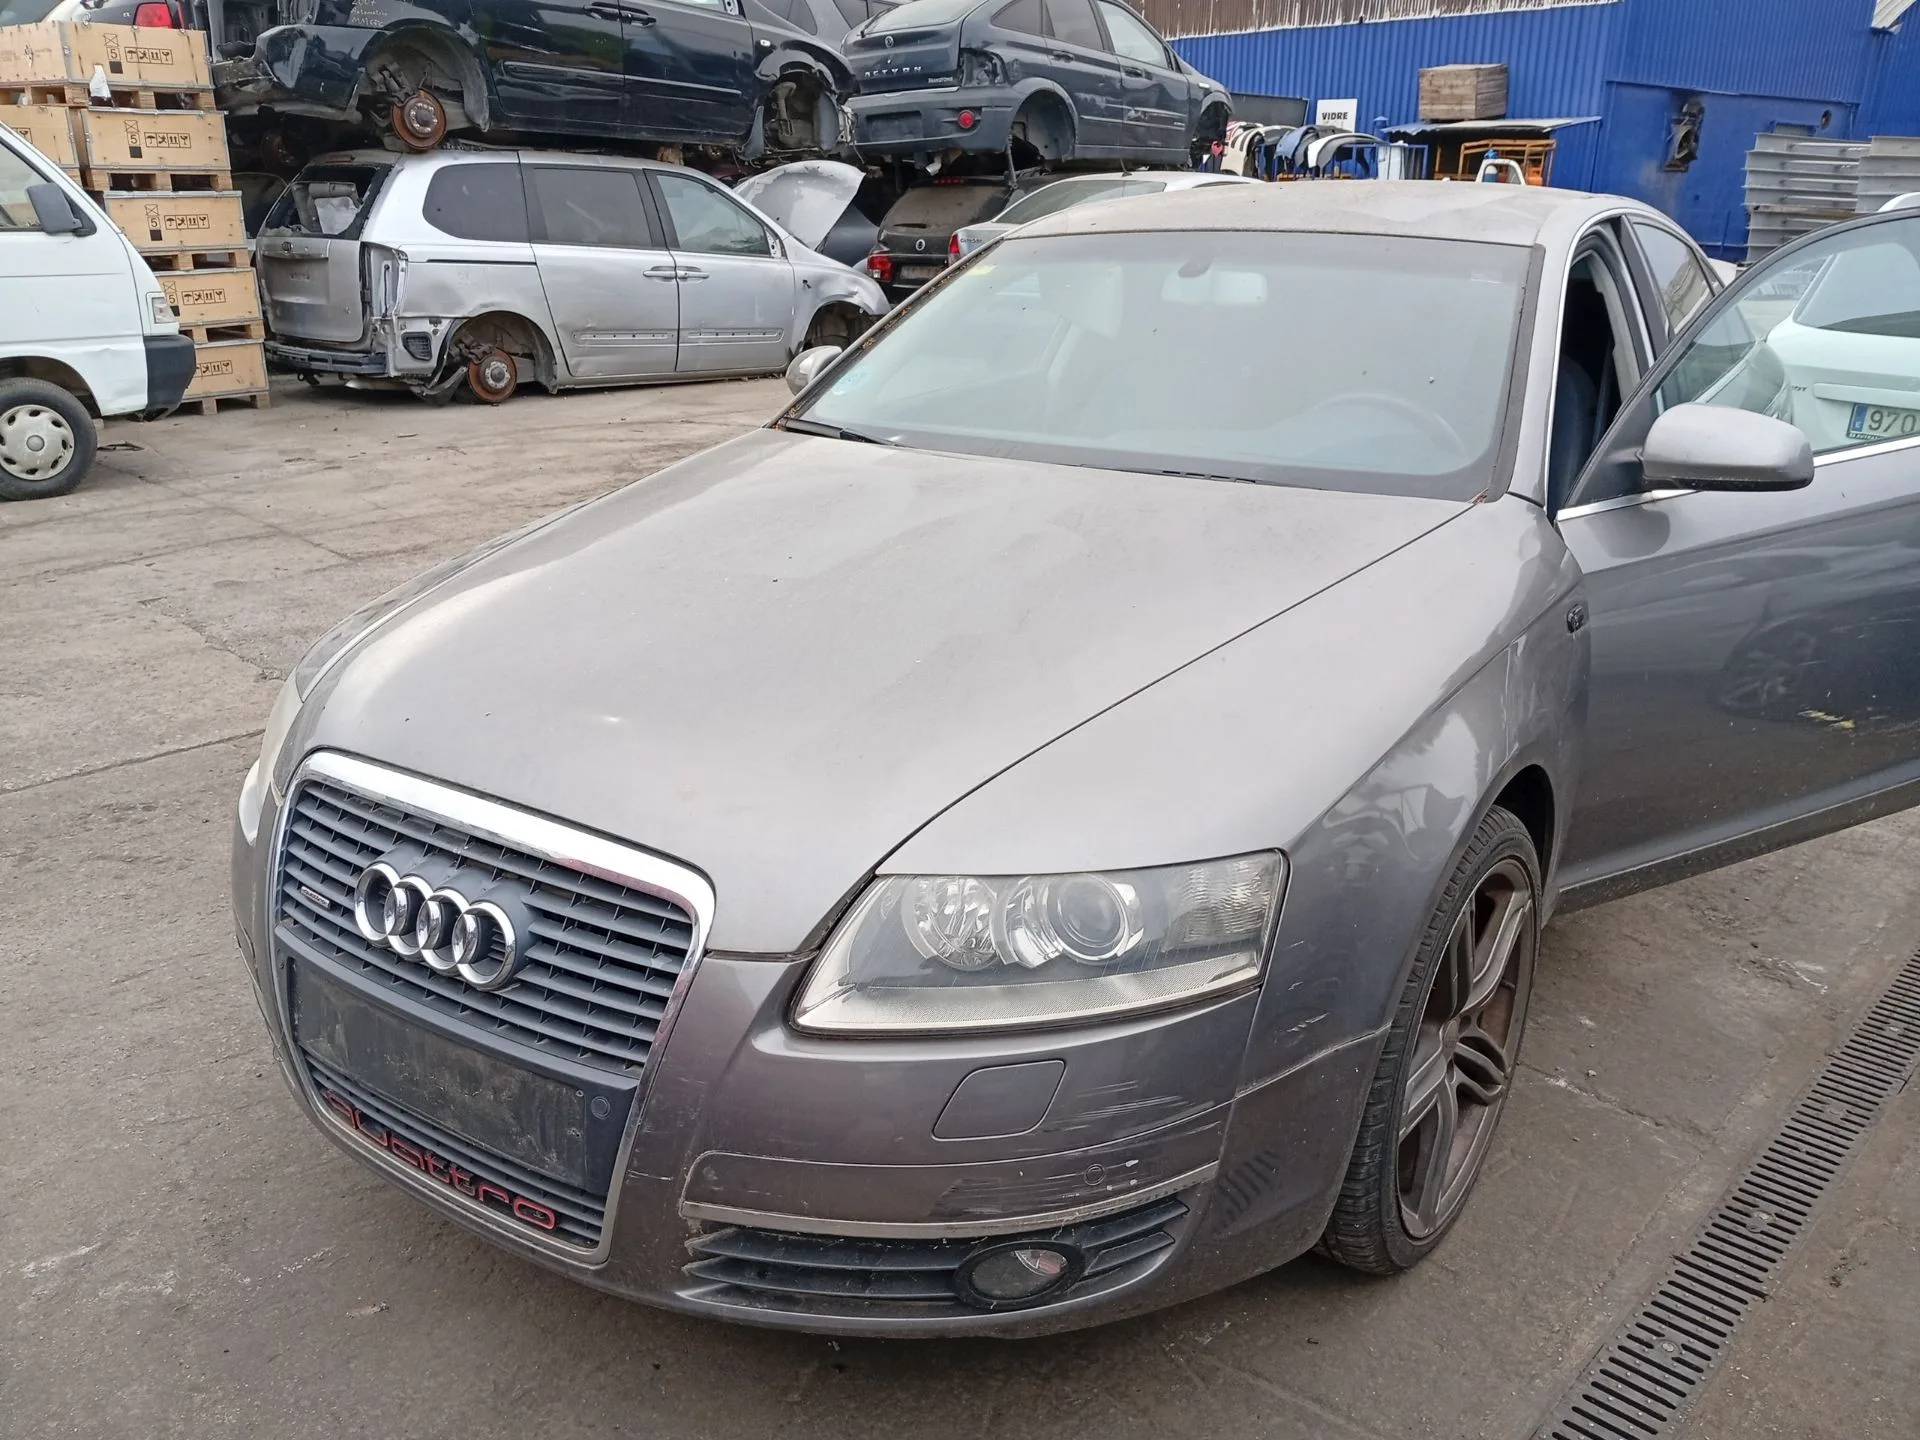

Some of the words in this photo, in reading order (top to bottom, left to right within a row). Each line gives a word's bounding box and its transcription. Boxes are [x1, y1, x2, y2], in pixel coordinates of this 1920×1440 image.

[110, 48, 118, 59] 5
[1321, 111, 1349, 121] VIDRE
[130, 134, 138, 144] 5
[150, 217, 158, 228] 5
[168, 294, 176, 304] 5
[319, 1086, 556, 1230] quattro
